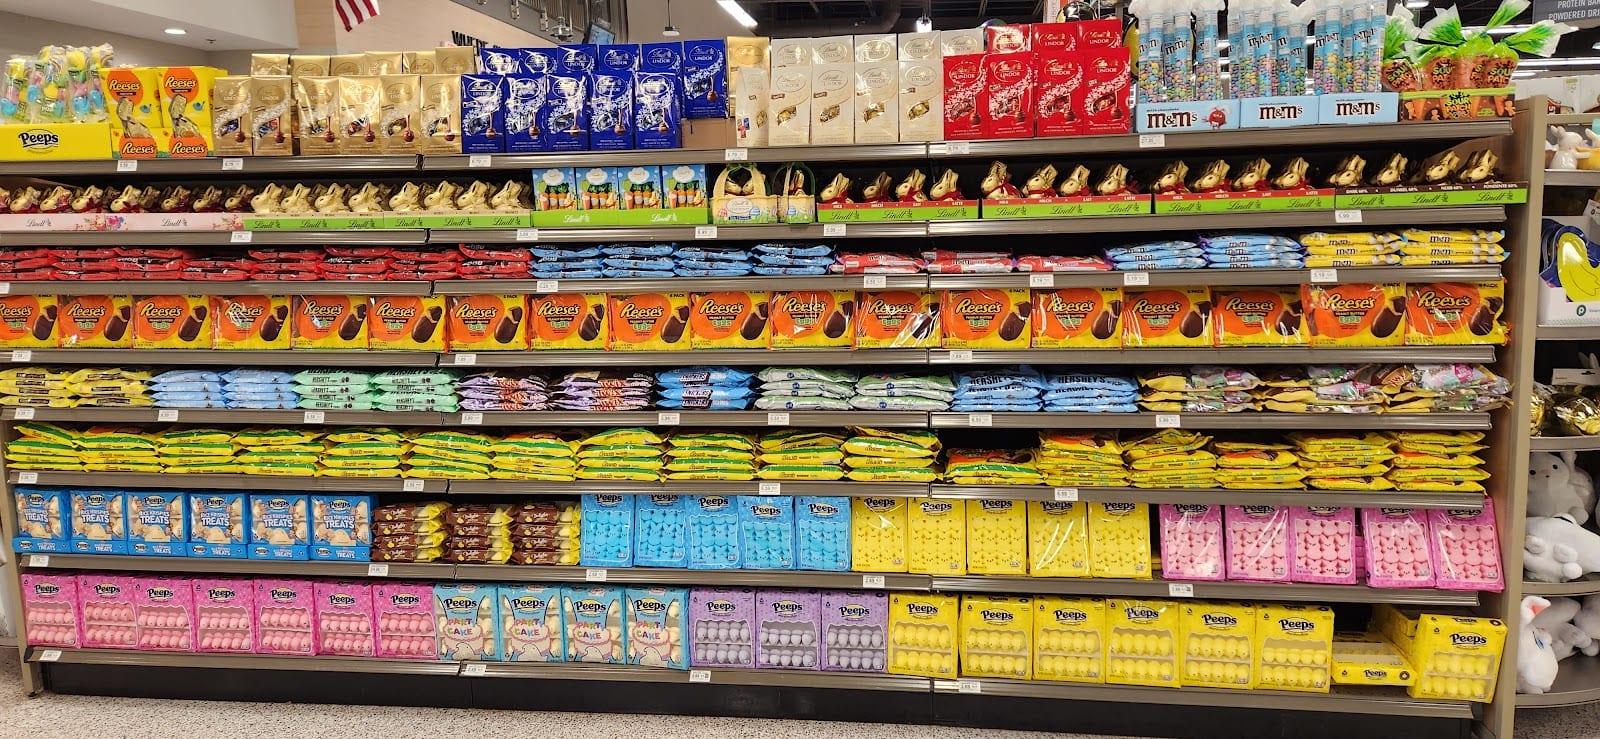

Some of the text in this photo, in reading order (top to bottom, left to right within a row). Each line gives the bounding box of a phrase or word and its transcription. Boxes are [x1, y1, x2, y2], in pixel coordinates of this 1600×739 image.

[1549, 10, 1585, 20] POWDERED
[109, 80, 140, 91] Reese's
[164, 77, 197, 88] Reese's
[18, 132, 59, 145] Peeps
[122, 142, 154, 155] Reese's
[172, 142, 205, 154] Reese's
[1350, 197, 1375, 206] Lindt
[1413, 195, 1438, 203] Lindt
[1477, 192, 1503, 201] Lindt
[1109, 205, 1132, 213] Lindt
[1169, 202, 1193, 211] Lindt
[1227, 201, 1252, 209] Lindt
[1288, 199, 1312, 208] Lindt
[832, 211, 852, 220] Lindt
[884, 210, 906, 219] Lindt
[937, 209, 960, 217] Lindt
[996, 208, 1019, 216] Lindt
[1052, 206, 1075, 214] Lindt
[782, 298, 828, 313] Reese's
[953, 298, 1002, 313] Reese's
[1133, 297, 1180, 313] Reese's
[1225, 297, 1274, 312] Reese's
[1325, 294, 1376, 310] Reese's
[1418, 292, 1472, 308] Reese's
[68, 303, 106, 316] Reese's
[140, 302, 182, 316] Reese's
[376, 302, 416, 316] Reese's
[456, 304, 497, 318] Reese's
[538, 302, 580, 315] Reese's
[621, 301, 663, 318] Reese's
[700, 299, 744, 313] Reese's
[594, 493, 622, 502] Peeps
[698, 496, 729, 508] Peeps
[864, 497, 895, 507] Peeps
[808, 503, 838, 515] Peeps
[980, 499, 1012, 509] Peeps
[1040, 500, 1072, 510] Peeps
[1102, 502, 1136, 511] Peeps
[750, 504, 782, 516] Peeps
[25, 513, 48, 523] TREATS
[82, 514, 109, 523] TREATS
[140, 515, 169, 524] TREATS
[201, 517, 229, 526] TREATS
[264, 519, 292, 527] TREATS
[325, 520, 354, 529] TREATS
[34, 584, 59, 594] Peeps
[94, 584, 120, 594] Peeps
[146, 588, 173, 598] Peeps
[208, 588, 236, 599] Peeps
[271, 588, 297, 599] Peeps
[329, 594, 355, 605] Peeps
[390, 594, 420, 604] Peeps
[444, 597, 477, 608] Peeps
[511, 598, 545, 608] Peeps
[573, 601, 606, 611] Peeps
[634, 600, 666, 611] Peeps
[706, 602, 736, 613] Peeps
[772, 602, 803, 613] Peeps
[906, 604, 938, 615] Peeps
[839, 606, 870, 617] Peeps
[980, 610, 1014, 622] Peeps
[1053, 610, 1087, 622] Peeps
[1124, 606, 1159, 619] Peeps
[1202, 613, 1237, 626] Peeps
[1280, 620, 1314, 631] Peeps
[447, 627, 473, 636] CAKE
[514, 627, 540, 636] CAKE
[576, 631, 602, 640] CAKE
[636, 631, 661, 640] CAKE
[1450, 633, 1487, 645] Peeps
